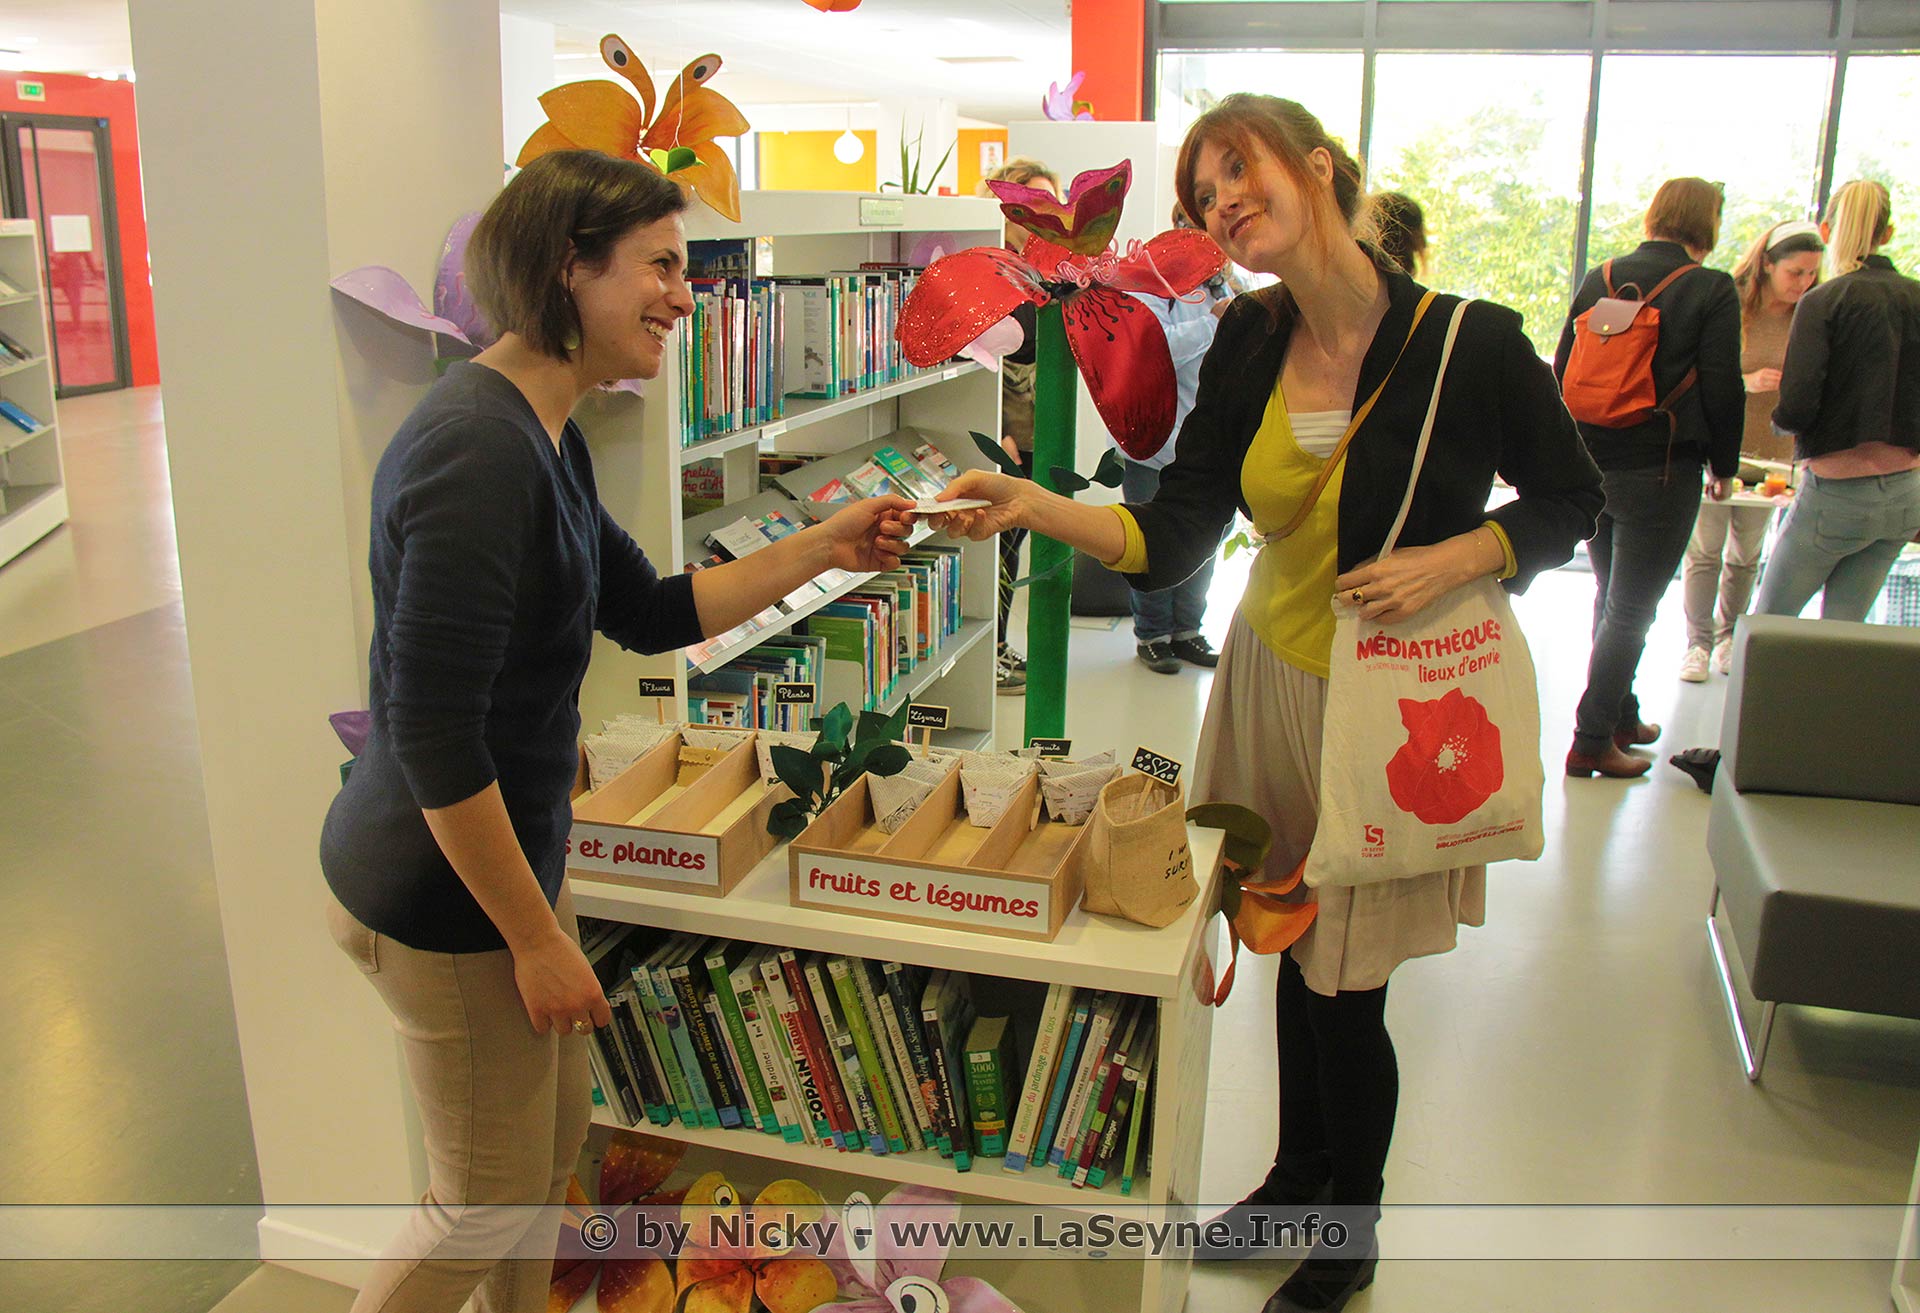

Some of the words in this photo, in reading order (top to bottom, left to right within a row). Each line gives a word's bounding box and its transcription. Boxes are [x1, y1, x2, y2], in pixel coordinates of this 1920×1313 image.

[1418, 664, 1455, 683] lieux
[1457, 648, 1500, 678] d'envie
[777, 686, 810, 699] Plantes
[910, 709, 943, 723] Légumes
[579, 839, 608, 859] et
[613, 841, 706, 871] plantes
[809, 867, 881, 898] fruits
[889, 880, 921, 902] et
[926, 883, 1039, 919] légumes
[1045, 1015, 1056, 1033] tous
[1041, 1034, 1052, 1054] pour
[761, 1051, 778, 1085] Jardiner
[1028, 1054, 1047, 1092] jardinage
[1026, 1091, 1036, 1102] du
[1018, 1103, 1033, 1132] manuel
[1015, 1132, 1026, 1143] Le
